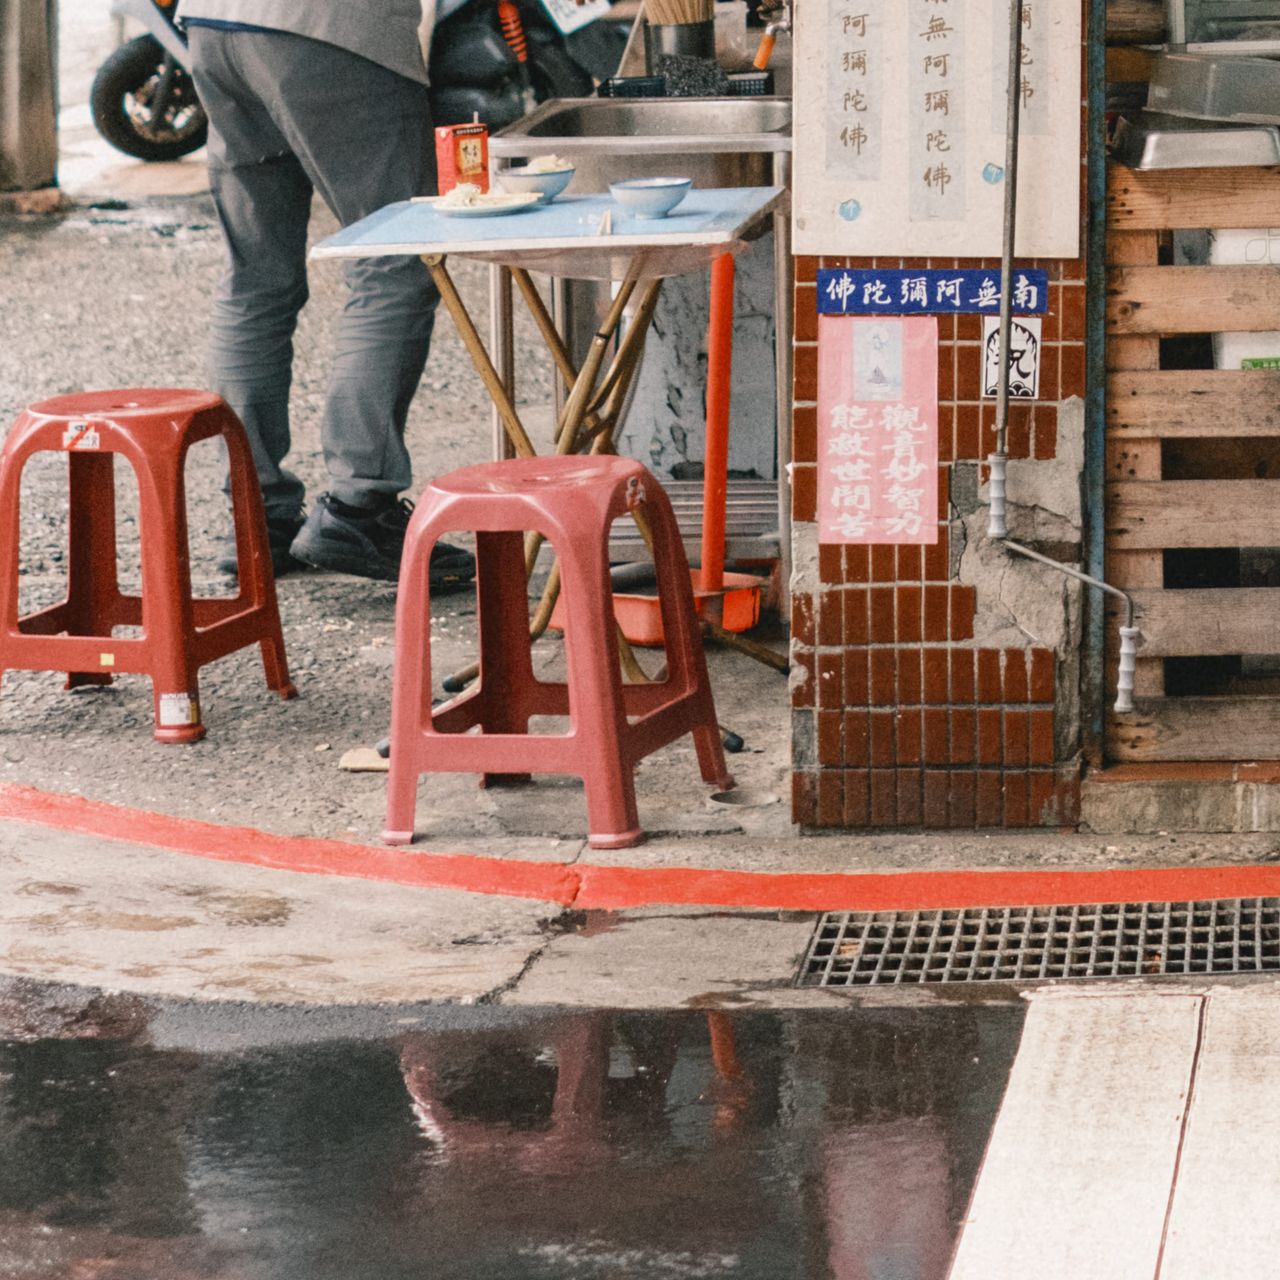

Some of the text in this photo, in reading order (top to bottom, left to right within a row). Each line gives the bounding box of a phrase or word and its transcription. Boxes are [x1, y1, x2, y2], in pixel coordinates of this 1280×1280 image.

[879, 403, 929, 536] 觀音妙智力
